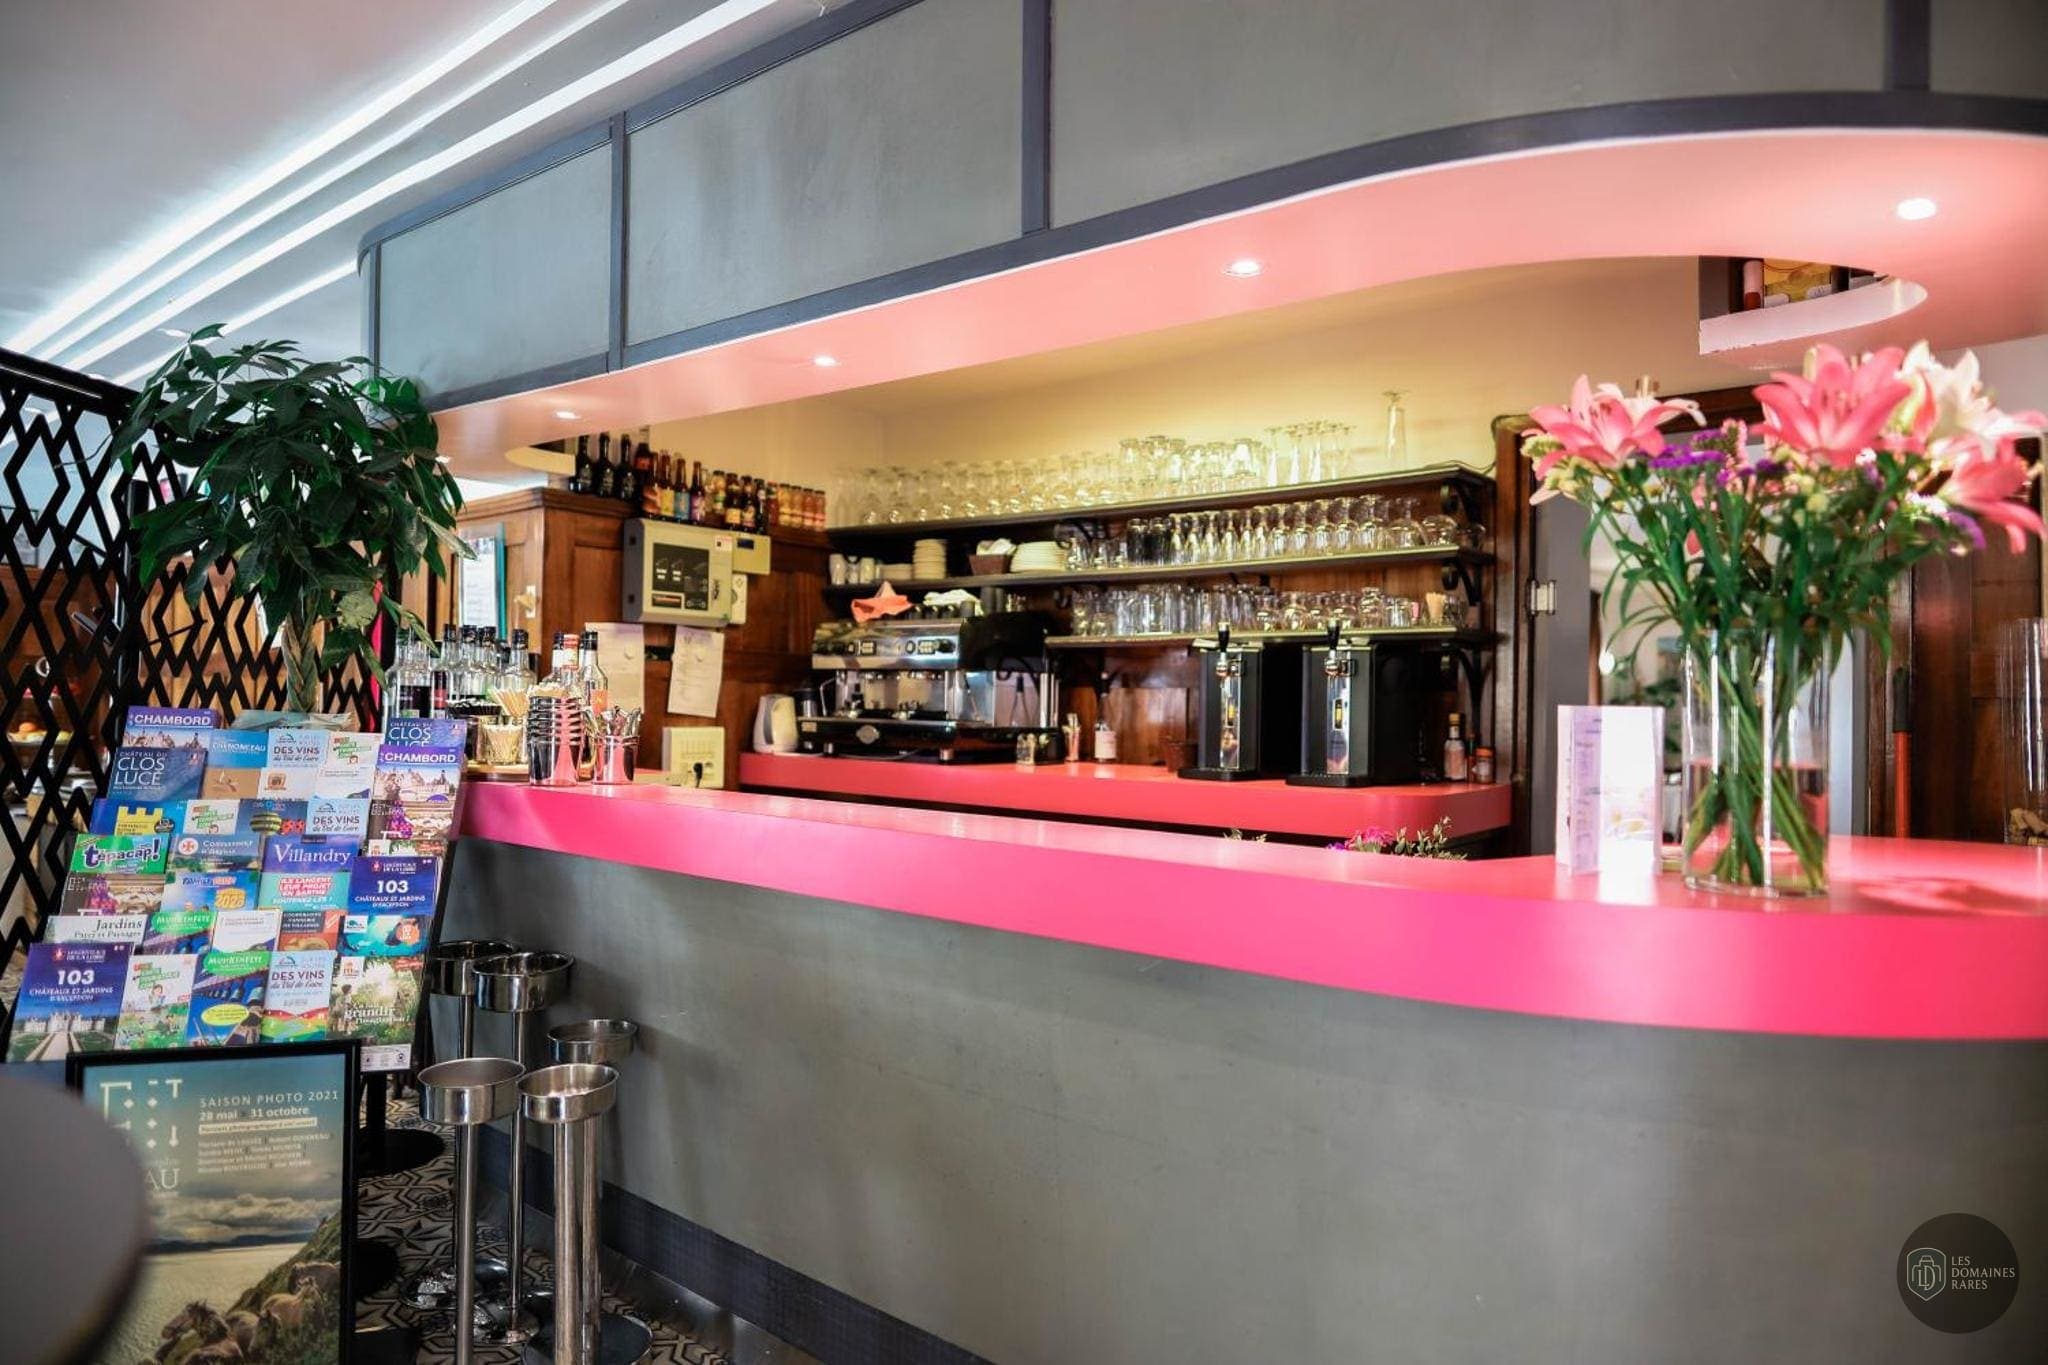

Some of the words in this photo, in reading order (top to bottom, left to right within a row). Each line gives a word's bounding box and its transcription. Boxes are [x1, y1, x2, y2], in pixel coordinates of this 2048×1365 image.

[134, 714, 211, 726] CHAMBORD
[388, 727, 431, 740] CLOS
[273, 746, 294, 754] DES
[296, 746, 320, 754] VINS
[118, 757, 165, 771] CLOS
[384, 752, 456, 763] CHAMBORD
[312, 816, 333, 825] DES
[336, 815, 360, 824] VINS
[274, 843, 351, 865] Villandry
[377, 880, 409, 894] 103
[96, 918, 142, 931] Jardins
[57, 970, 95, 985] 103
[272, 971, 294, 981] DES
[297, 970, 325, 979] VINS
[200, 1096, 251, 1108] SAISON
[257, 1092, 303, 1104] PHOTO
[308, 1090, 338, 1101] 2021
[200, 1112, 213, 1121] 28
[215, 1109, 237, 1120] mai
[266, 1105, 310, 1116] octobre
